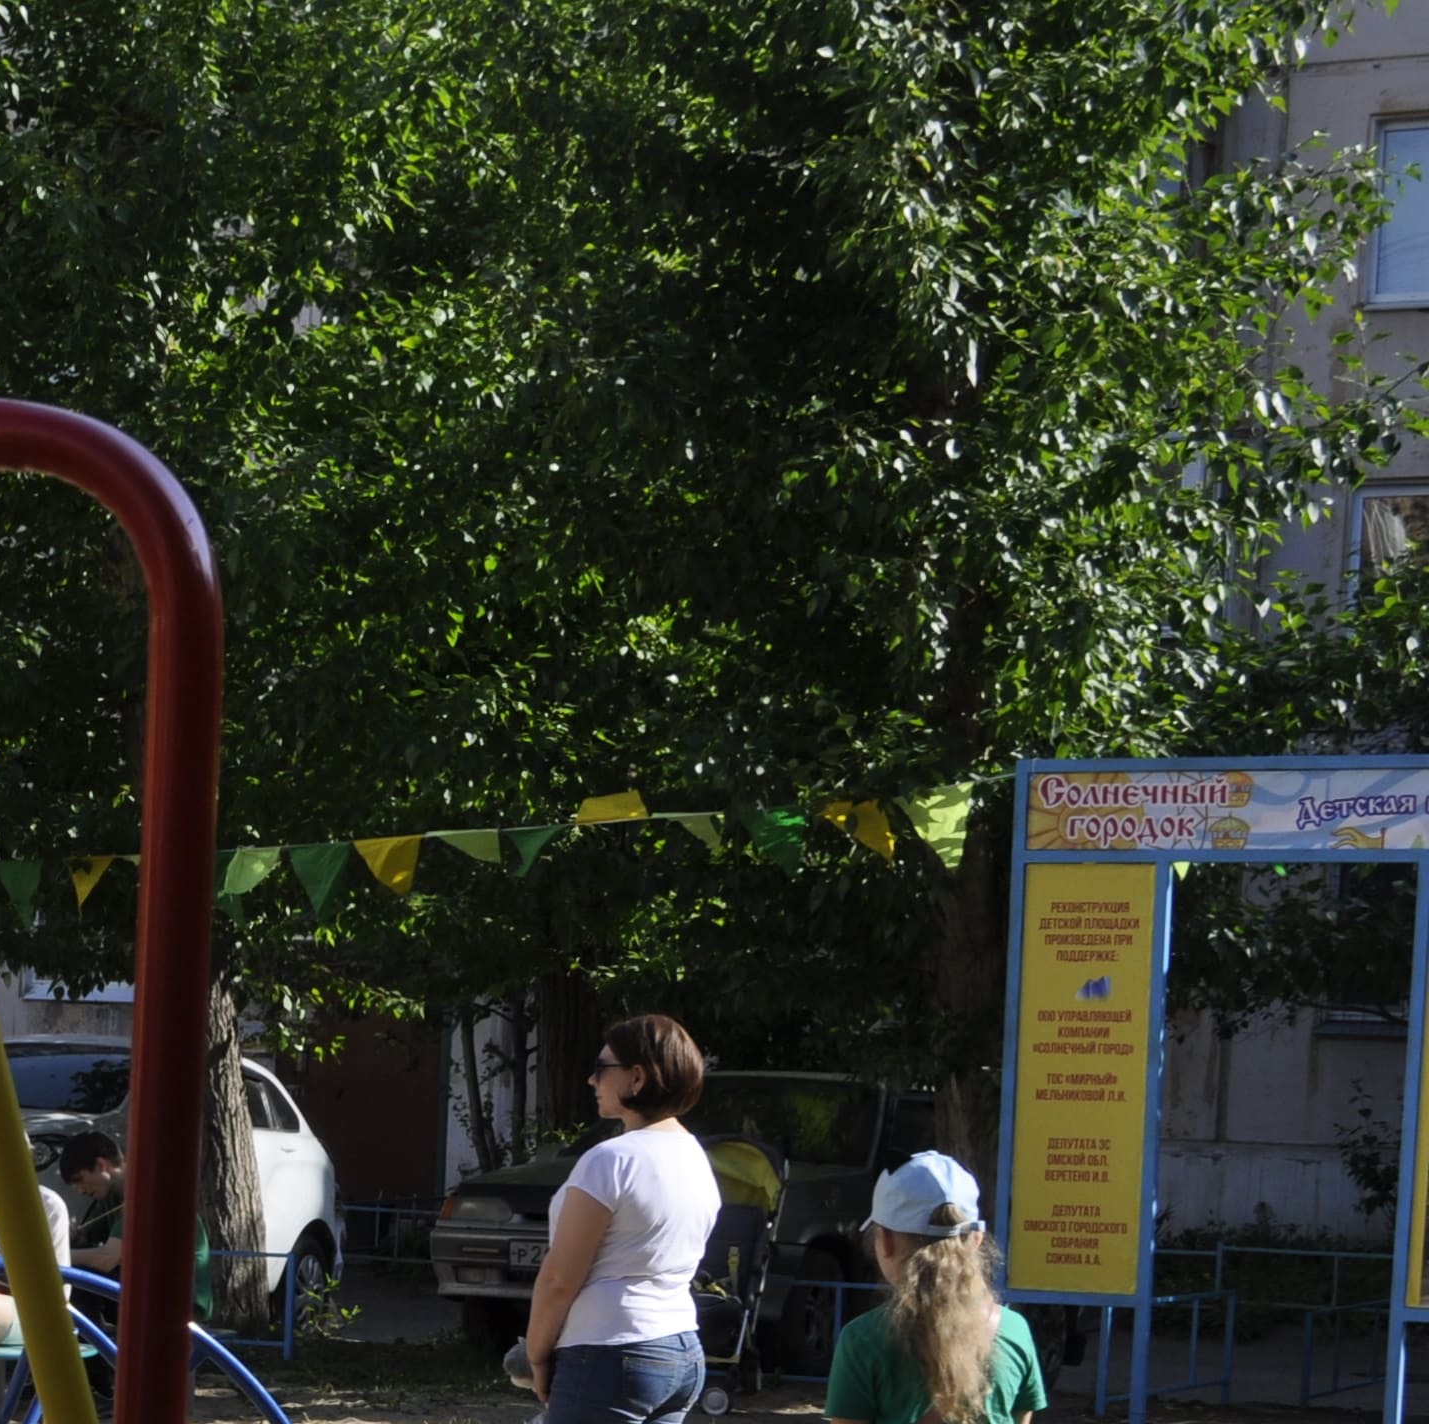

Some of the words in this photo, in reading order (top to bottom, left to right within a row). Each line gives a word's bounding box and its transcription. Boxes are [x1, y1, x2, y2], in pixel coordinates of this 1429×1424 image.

[1041, 774, 1228, 807] Солнечный
[1296, 795, 1417, 830] Детская
[1068, 812, 1196, 848] городок
[1050, 901, 1130, 914] РЕКОНСТРУКЦИЯ
[1039, 918, 1082, 930] ДЕТСКОЙ
[1084, 918, 1140, 930] ПЛОЩАДКИ
[1045, 934, 1111, 946] ПРОИЗВЕДЕНА
[1114, 934, 1133, 946] ПРИ
[1058, 1009, 1132, 1022] УПРАВЛЯЮЩЕЙ
[1046, 1073, 1063, 1084] ТОС
[1035, 1089, 1105, 1101] МЕЛЬНИКОВОЙ
[1047, 1138, 1097, 1150] ДЕПУТАТА
[1047, 1154, 1085, 1166] ОМСКОЙ
[1052, 1205, 1100, 1217] ДЕПУТАТА
[1023, 1220, 1067, 1232] ОМСКОГО
[1068, 1221, 1128, 1234] ГОРОДСКОГО
[1051, 1237, 1099, 1249] СОБРАНИЯ
